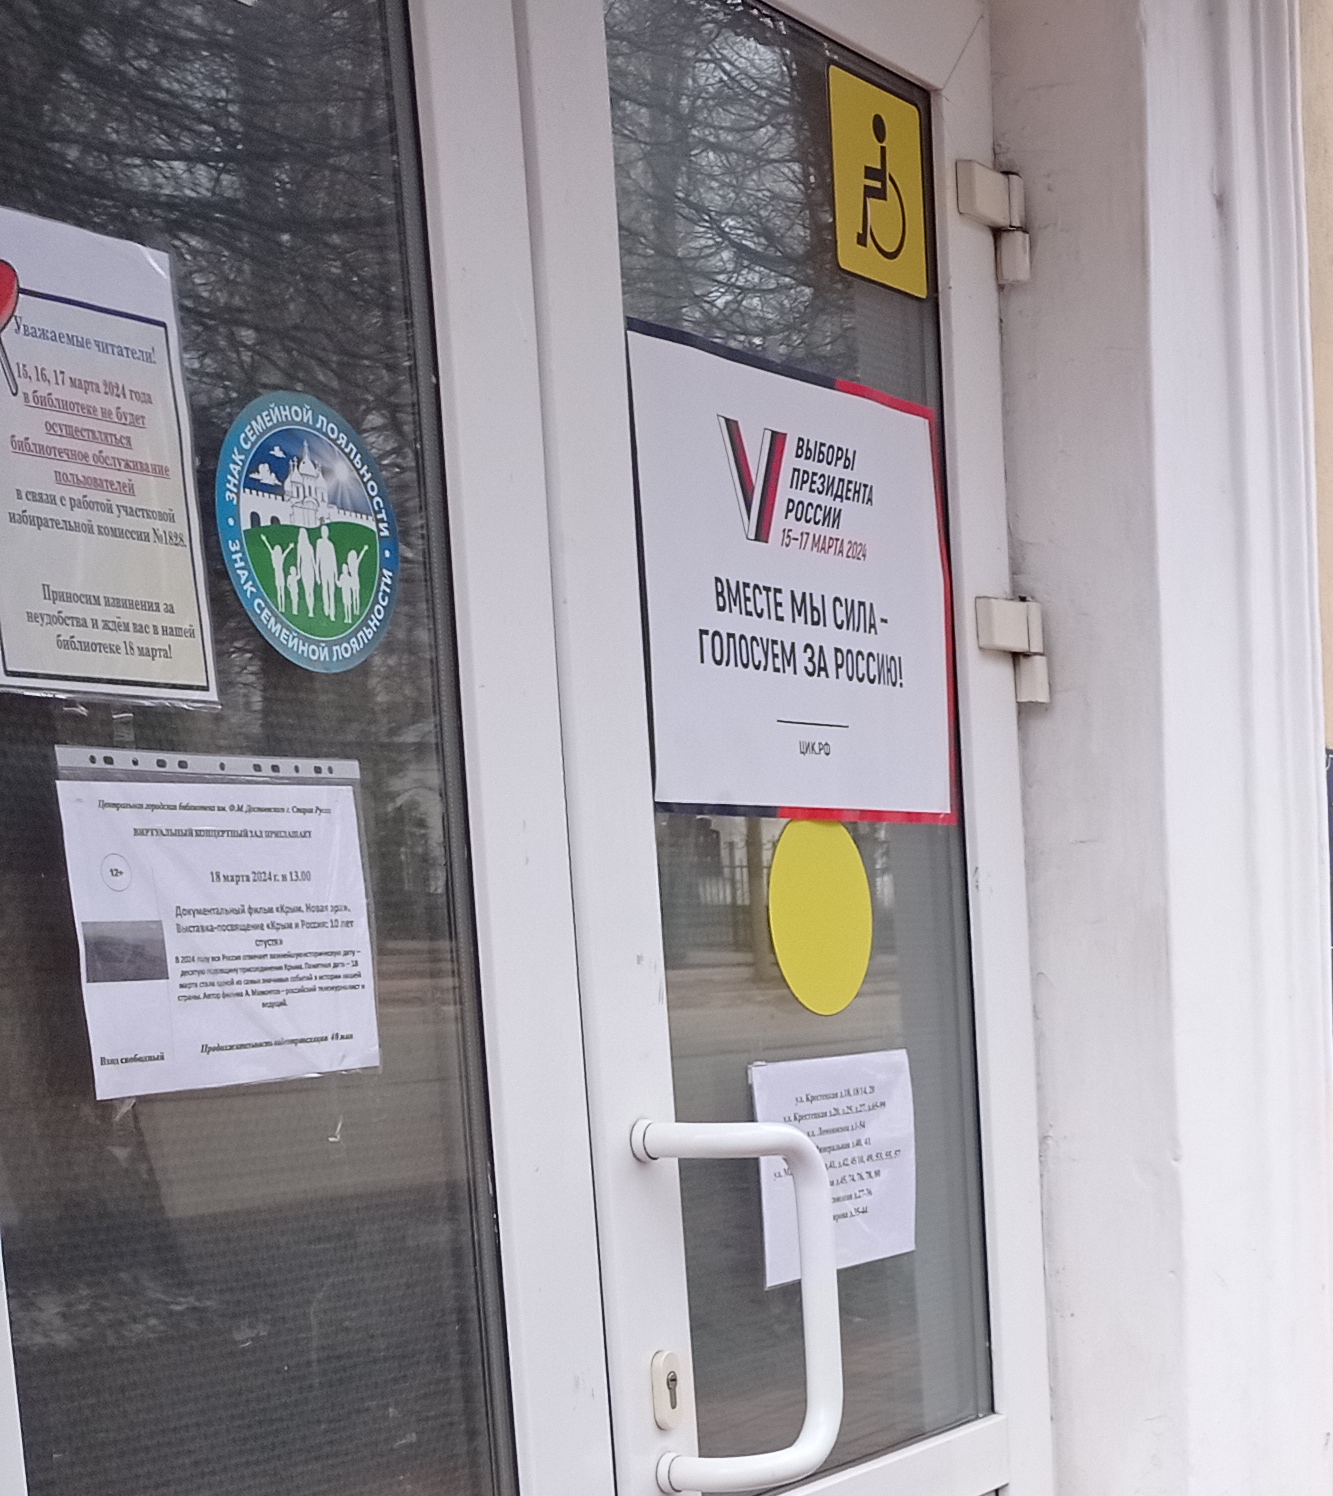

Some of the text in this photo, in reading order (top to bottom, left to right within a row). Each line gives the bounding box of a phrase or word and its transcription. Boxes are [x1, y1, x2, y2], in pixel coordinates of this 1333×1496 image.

[14, 315, 156, 364] Уважаемые читатели!
[16, 362, 153, 404] 15, 16, 17 марта 2024 года
[32, 390, 98, 417] библиотеке
[101, 408, 113, 419] не
[116, 407, 146, 426] будет
[45, 421, 132, 447] осуществляться
[10, 435, 171, 476] библиотечное обслуживание
[225, 403, 390, 537] ЗНАК СЕМЕЙНОЙ ЛОЯЛЬНОСТИ
[794, 436, 857, 471] ВЫБОРЫ
[54, 470, 135, 494] пользователей
[790, 467, 874, 506] ПРЕЗИДЕНТА
[15, 489, 176, 523] в связи с работой участковой
[784, 498, 842, 530] РОССИИ
[8, 510, 95, 534] избирательной
[97, 524, 150, 542] комиссии
[811, 533, 844, 557] МАРТА
[846, 540, 867, 562] 2024
[42, 583, 175, 614] Приносим извинения за
[229, 539, 393, 662] ЗНАК СЕМЕЙНОЙ ЛОЯЛЬНОСТИ
[714, 576, 785, 622] ВМЕСТЕ
[790, 589, 827, 628] МЫ
[26, 610, 196, 638] неудобства и ждём вас в нашей
[56, 634, 173, 661] библиотеке 18 марта!
[698, 628, 904, 688] ГОЛОСУЕМ ЗА РОССИЮ!
[799, 740, 831, 756] ЦИК.РФ
[210, 871, 220, 883] 18
[223, 873, 250, 885] марта
[252, 871, 272, 882] 2024
[289, 871, 311, 882] 13.00
